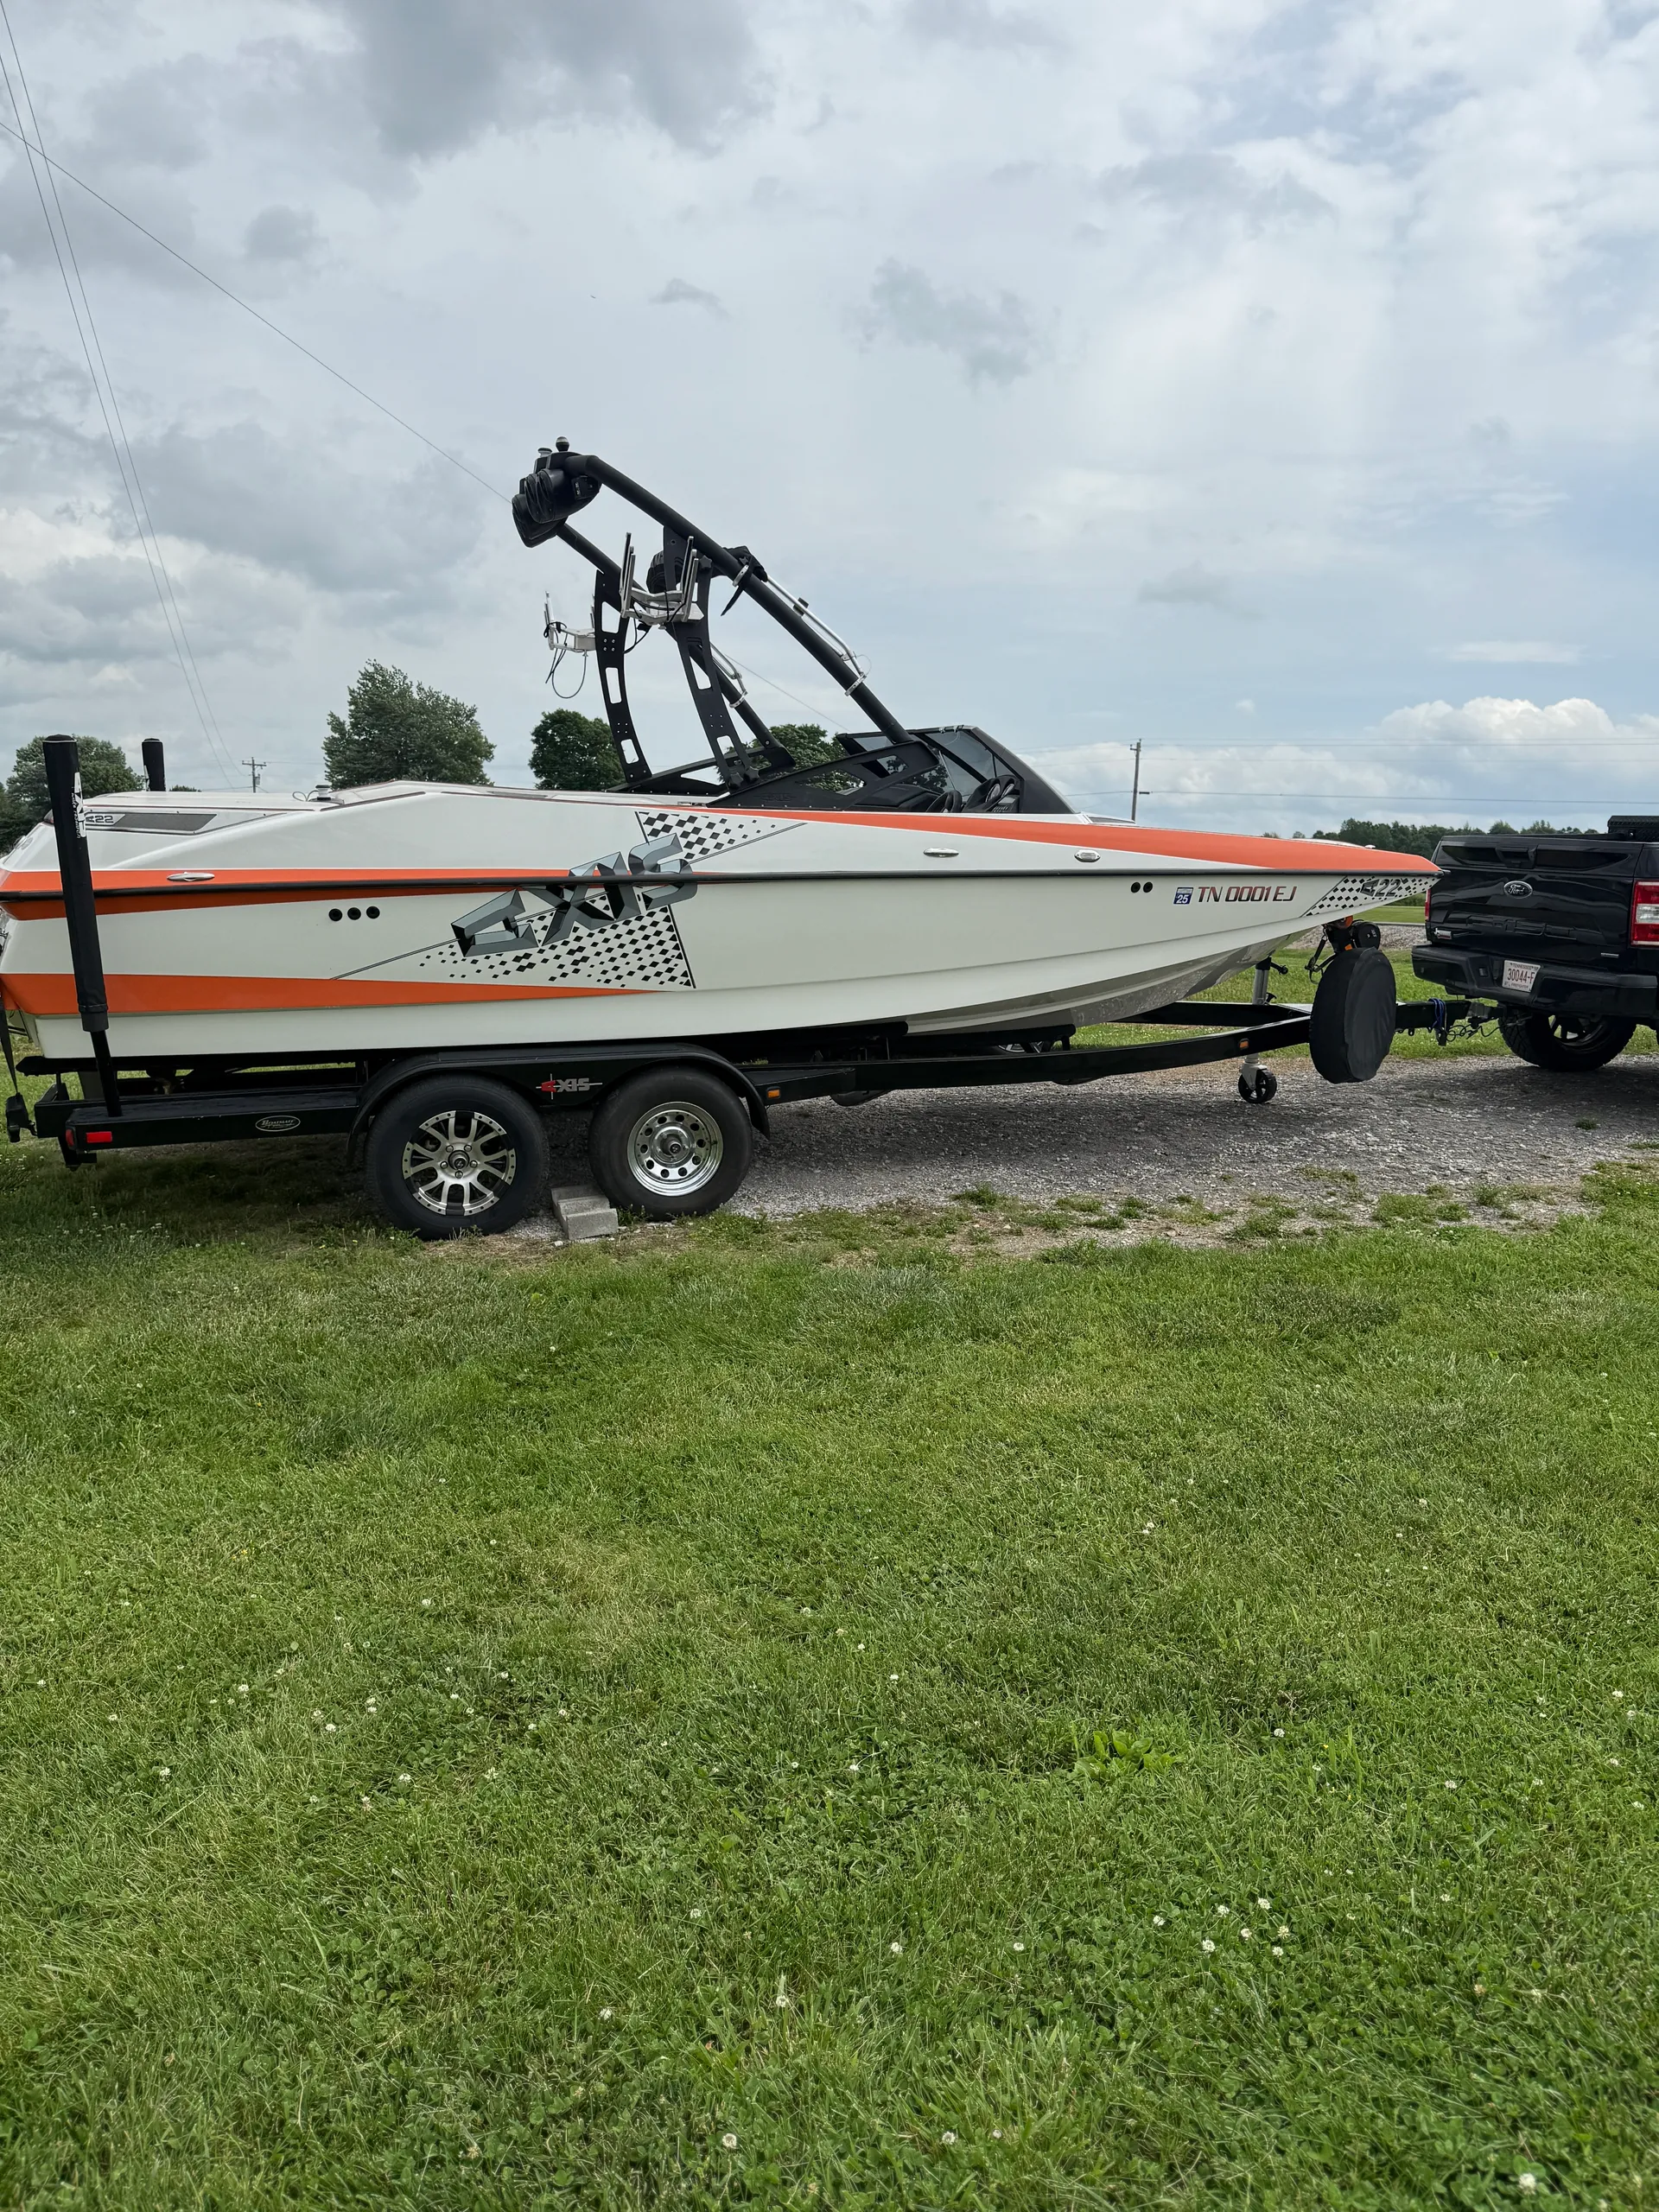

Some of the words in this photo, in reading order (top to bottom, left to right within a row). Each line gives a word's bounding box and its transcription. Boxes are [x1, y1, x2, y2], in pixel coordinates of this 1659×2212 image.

[450, 832, 698, 958] AXIS
[1176, 894, 1190, 904] 25
[1198, 886, 1223, 903] TN
[1225, 886, 1272, 902] 0001
[1273, 886, 1298, 902] EJ
[1507, 968, 1535, 984] 30044-F
[541, 1077, 591, 1093] AXIS
